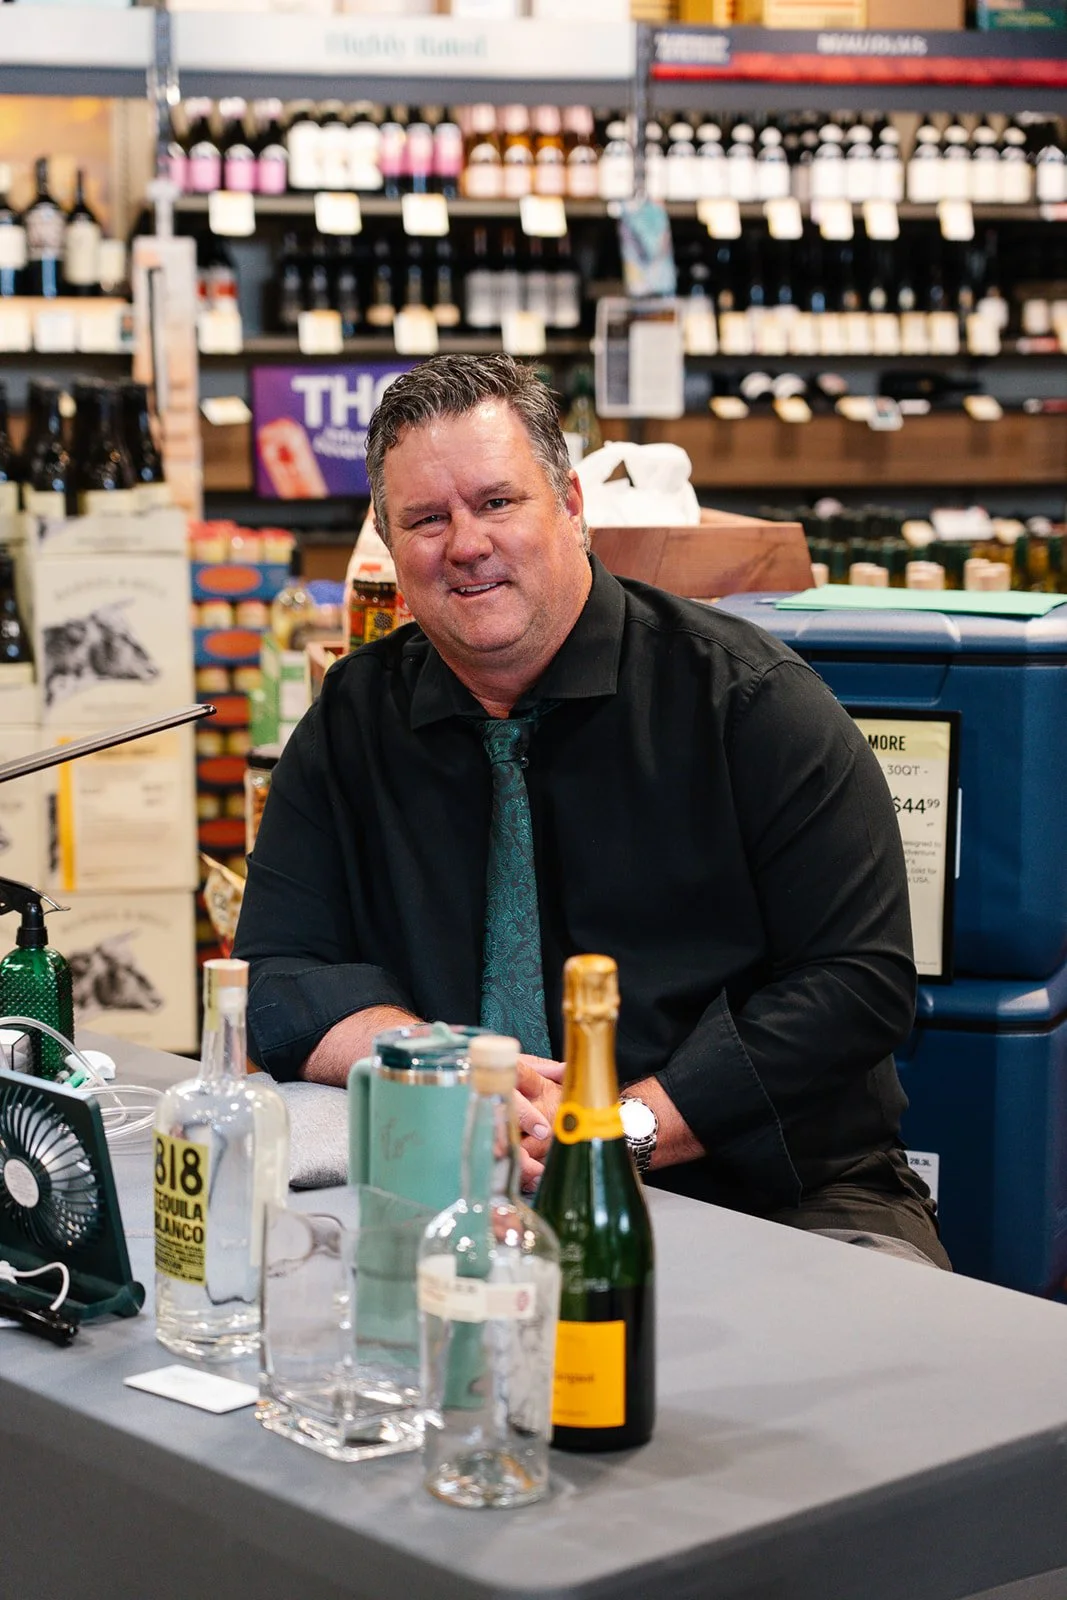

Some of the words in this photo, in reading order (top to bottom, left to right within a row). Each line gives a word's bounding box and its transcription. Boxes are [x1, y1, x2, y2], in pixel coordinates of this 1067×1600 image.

[868, 735, 906, 751] MORE
[887, 765, 920, 776] 30QT
[155, 1137, 203, 1196] 818
